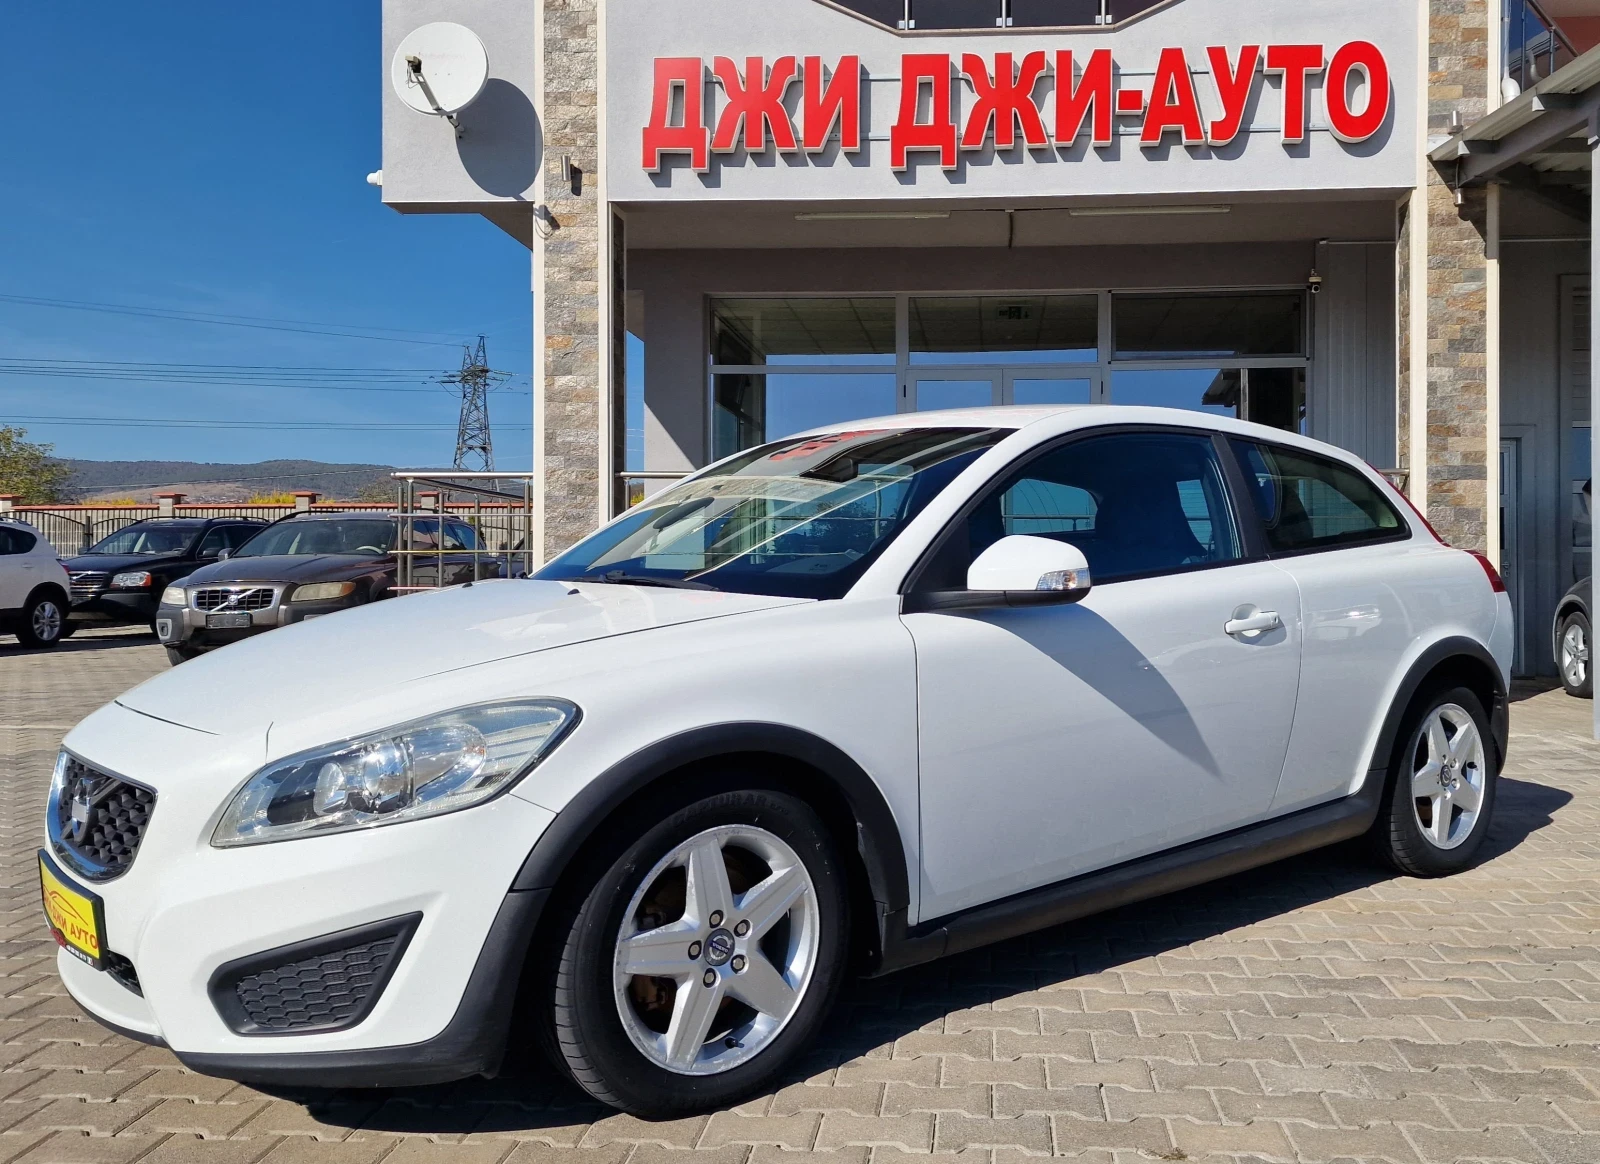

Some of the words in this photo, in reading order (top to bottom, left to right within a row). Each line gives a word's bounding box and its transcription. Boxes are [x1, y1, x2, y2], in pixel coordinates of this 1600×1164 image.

[642, 54, 861, 173] ДЖИ
[890, 40, 1391, 172] ДЖИ-АУТО
[70, 923, 99, 950] АУТО
